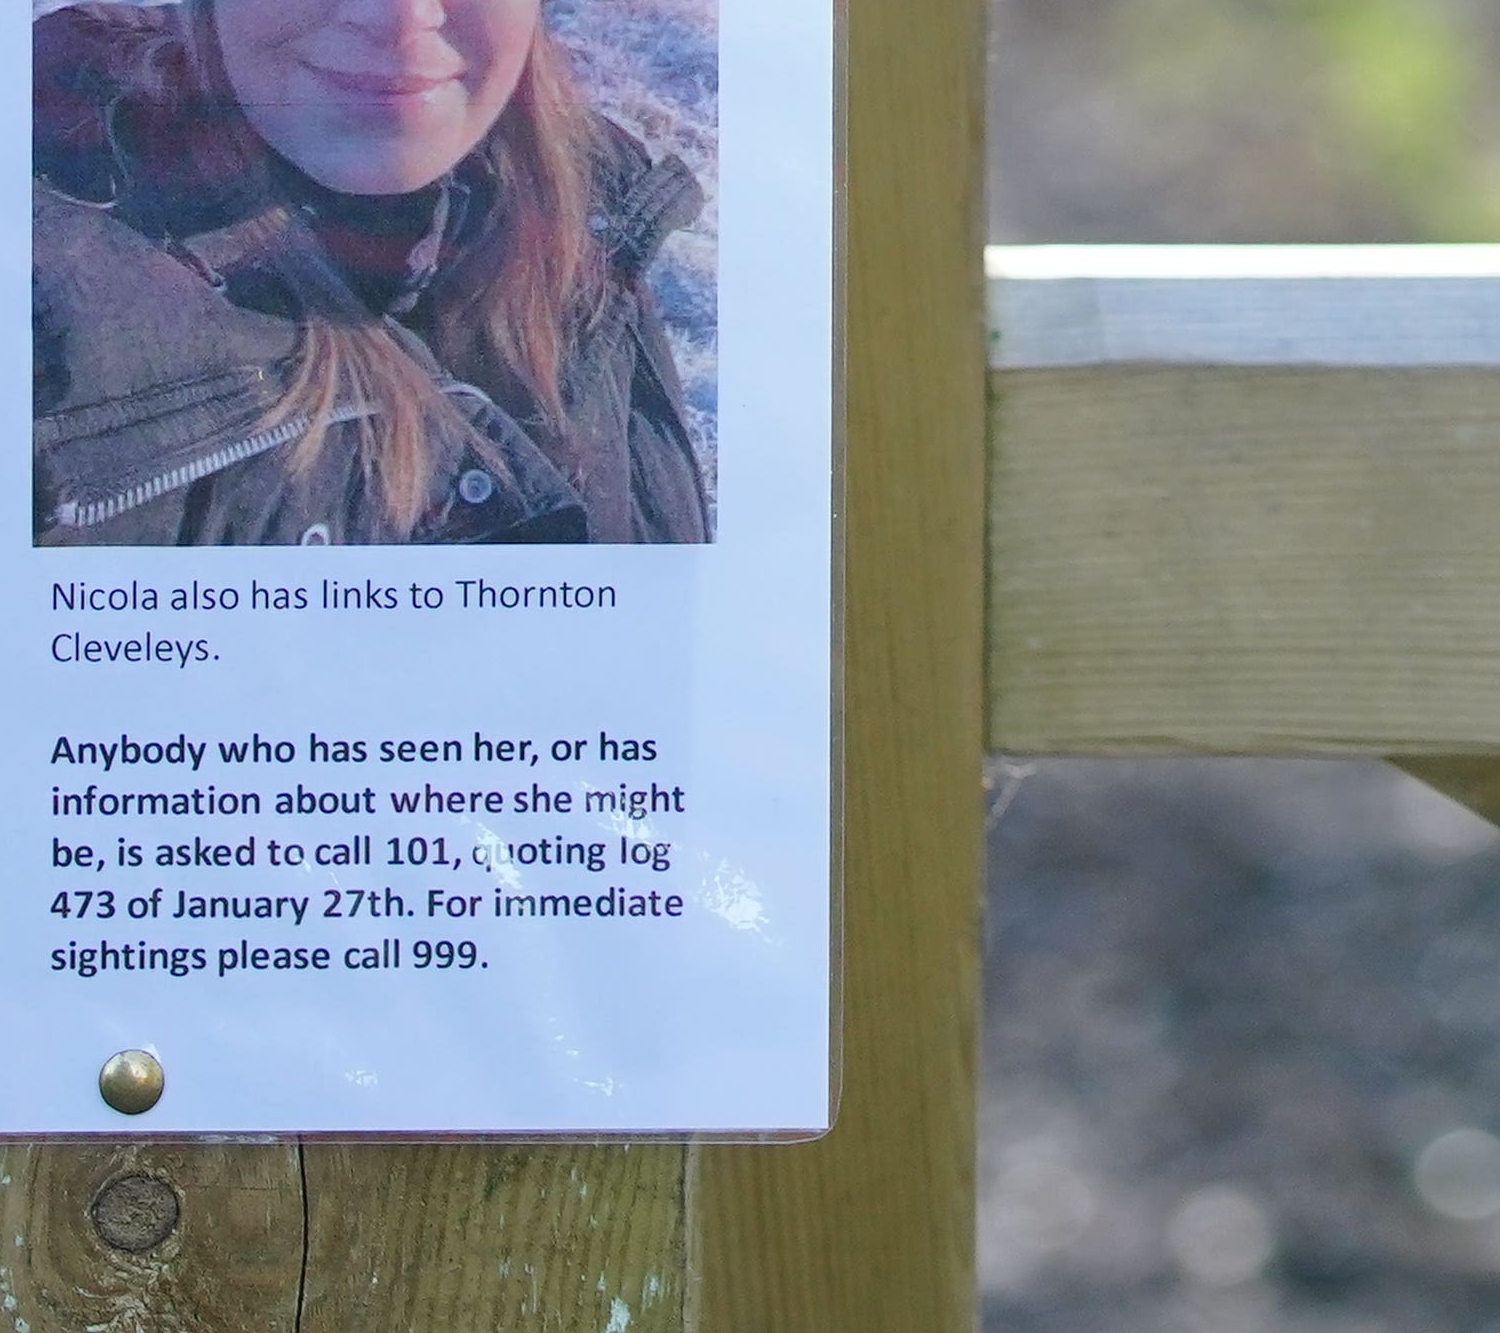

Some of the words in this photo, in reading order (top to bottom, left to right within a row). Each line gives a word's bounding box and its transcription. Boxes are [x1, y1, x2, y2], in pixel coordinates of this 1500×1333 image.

[53, 580, 158, 611] Nicola
[171, 580, 239, 611] also
[252, 579, 308, 610] has
[323, 579, 398, 609] links
[409, 582, 444, 609] to
[455, 578, 615, 608] Thornton
[52, 631, 219, 669] Cleveleys.
[50, 733, 207, 772] Anybody
[218, 733, 295, 763] who
[310, 733, 367, 763] has
[379, 740, 462, 763] seen
[474, 731, 538, 767] her,
[551, 740, 588, 762] or
[600, 731, 657, 761] has
[52, 785, 260, 816] information
[275, 784, 376, 815] about
[390, 783, 503, 813] where
[513, 783, 572, 813] she
[585, 784, 685, 821] might
[52, 837, 105, 872] be,
[118, 837, 143, 867] is
[155, 836, 255, 867] asked
[267, 840, 304, 866] to
[315, 835, 370, 866] call
[387, 837, 461, 871] 101,
[472, 835, 606, 873] quoting
[621, 836, 671, 872] log
[50, 890, 116, 919] 473
[127, 888, 163, 919] of
[172, 890, 309, 926] January
[323, 887, 414, 918] 27th.
[428, 889, 482, 918] For
[494, 886, 683, 917] immediate
[51, 940, 207, 978] sightings
[218, 939, 330, 977] please
[344, 938, 400, 969] call
[412, 940, 488, 969] 999.
